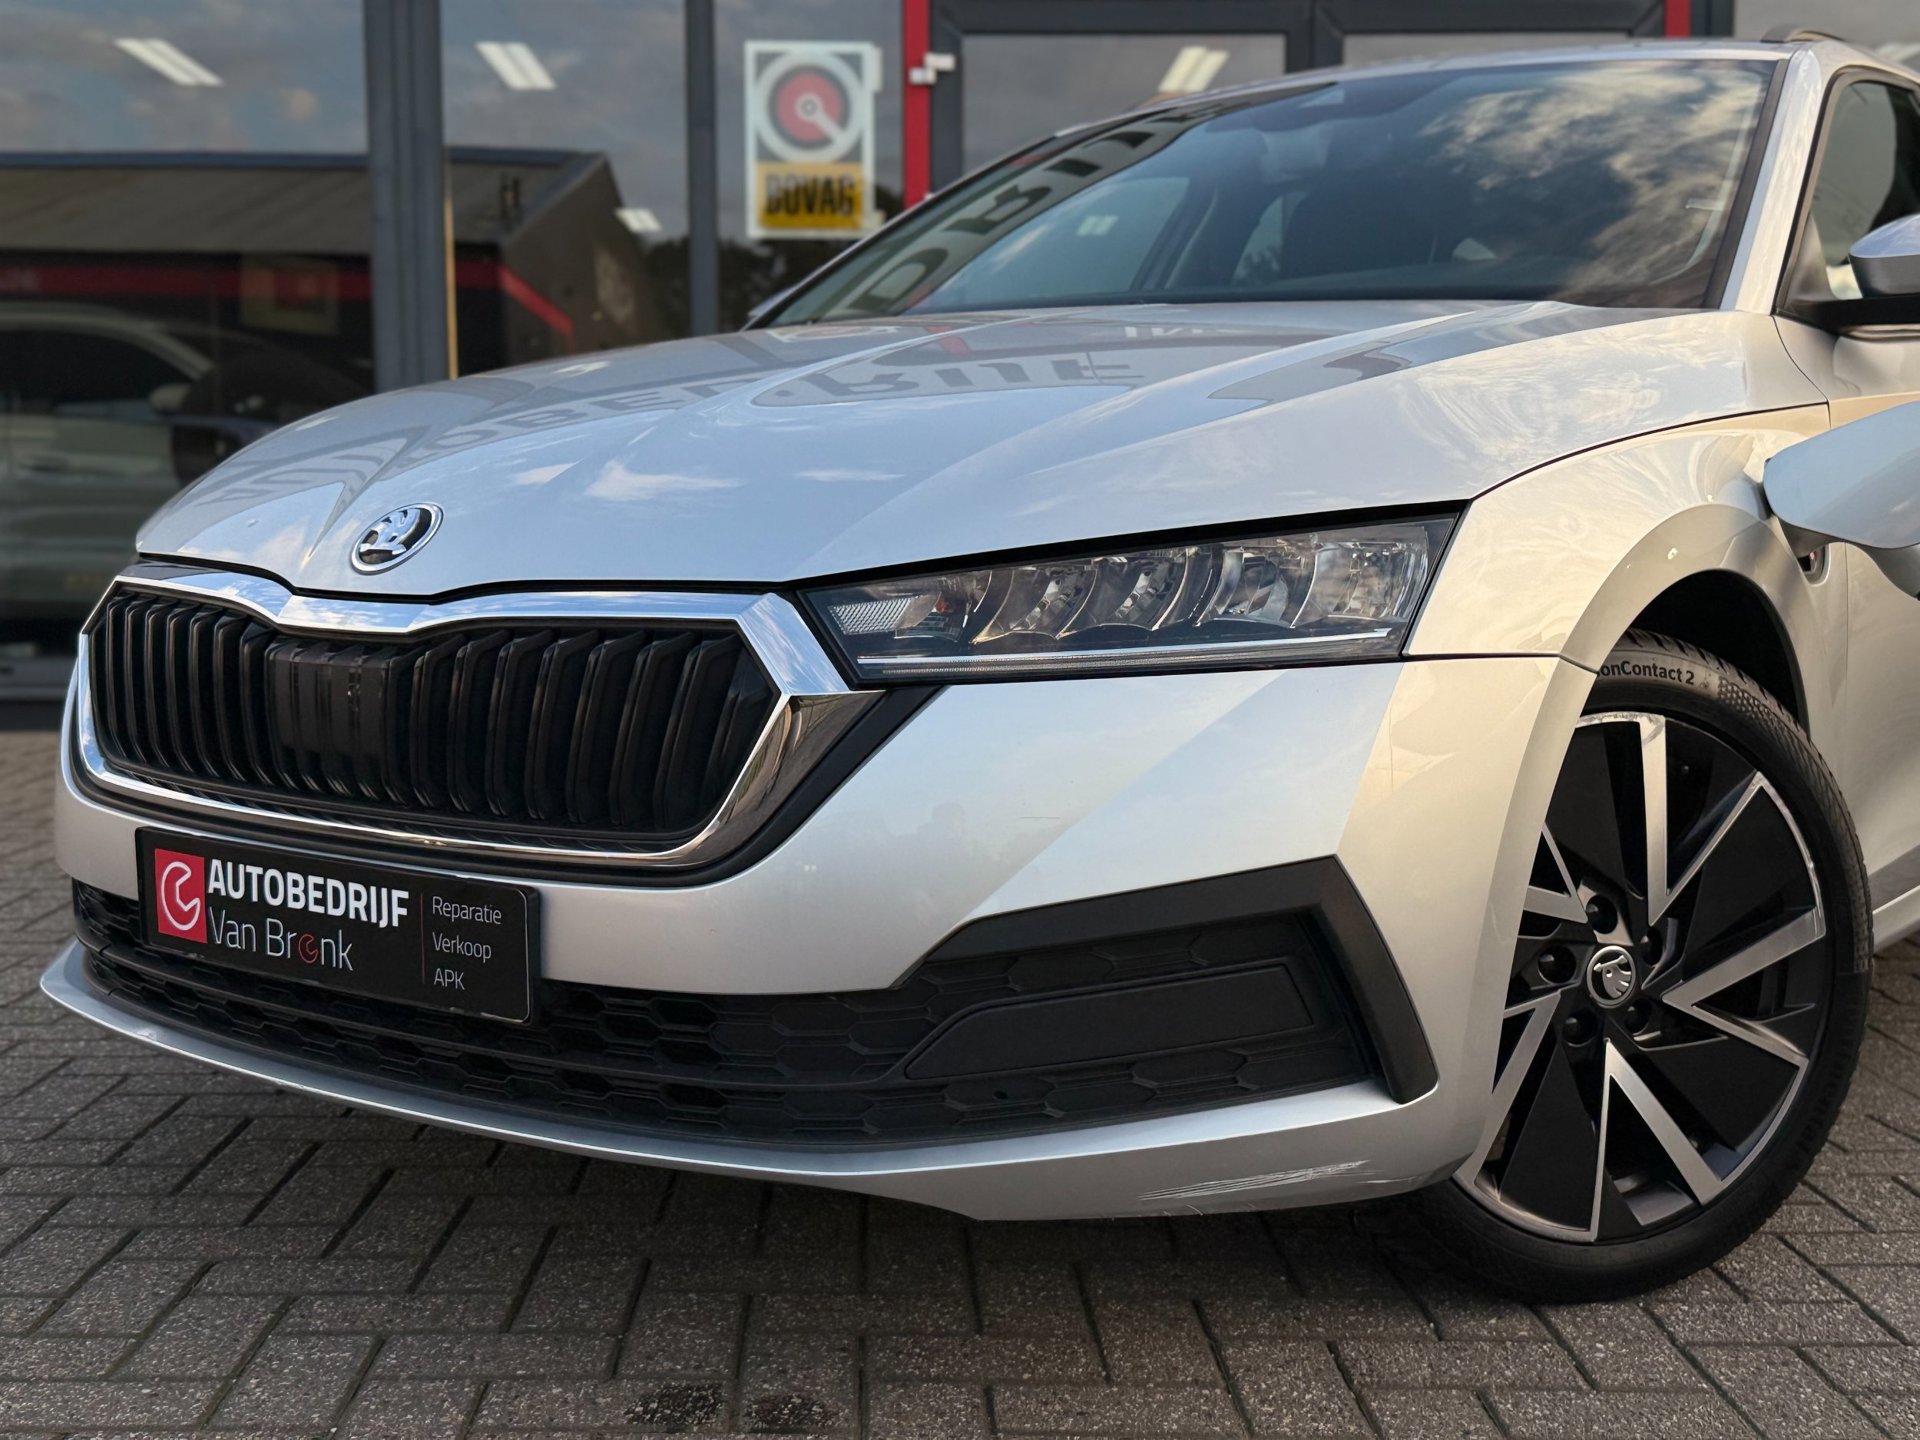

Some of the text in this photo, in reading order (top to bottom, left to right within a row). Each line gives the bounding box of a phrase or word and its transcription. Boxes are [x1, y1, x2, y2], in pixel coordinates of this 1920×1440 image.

[1597, 660, 1695, 686] onContact 2
[208, 858, 409, 928] AUTOBEDRIJF
[432, 895, 502, 925] Reparatie
[208, 906, 257, 953] Van
[432, 931, 492, 964] Verkoop
[433, 967, 466, 991] APK
